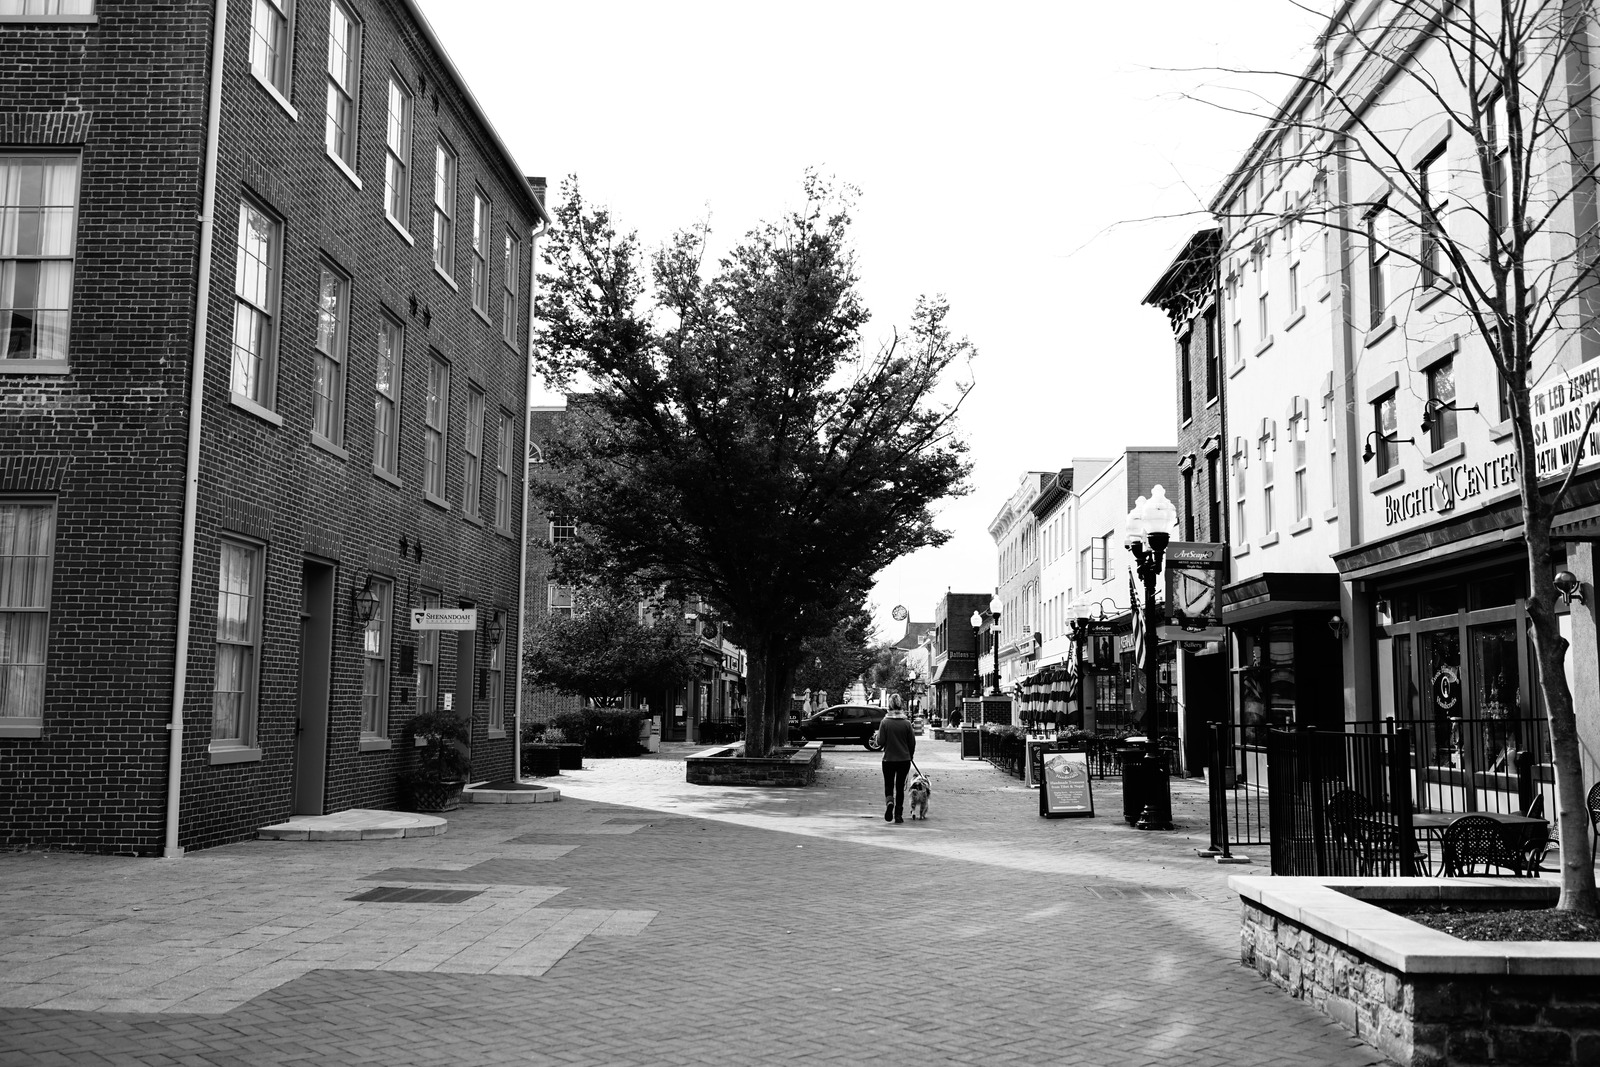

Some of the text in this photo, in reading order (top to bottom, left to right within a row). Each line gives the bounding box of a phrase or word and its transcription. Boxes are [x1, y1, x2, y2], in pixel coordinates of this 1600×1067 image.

[1548, 384, 1565, 411] LED
[1534, 421, 1548, 446] SA
[1553, 407, 1581, 439] DIVAS
[1536, 447, 1557, 474] 14TH
[1385, 452, 1520, 527] BRIGHT CENTER
[426, 612, 471, 620] SHENANDOAH
